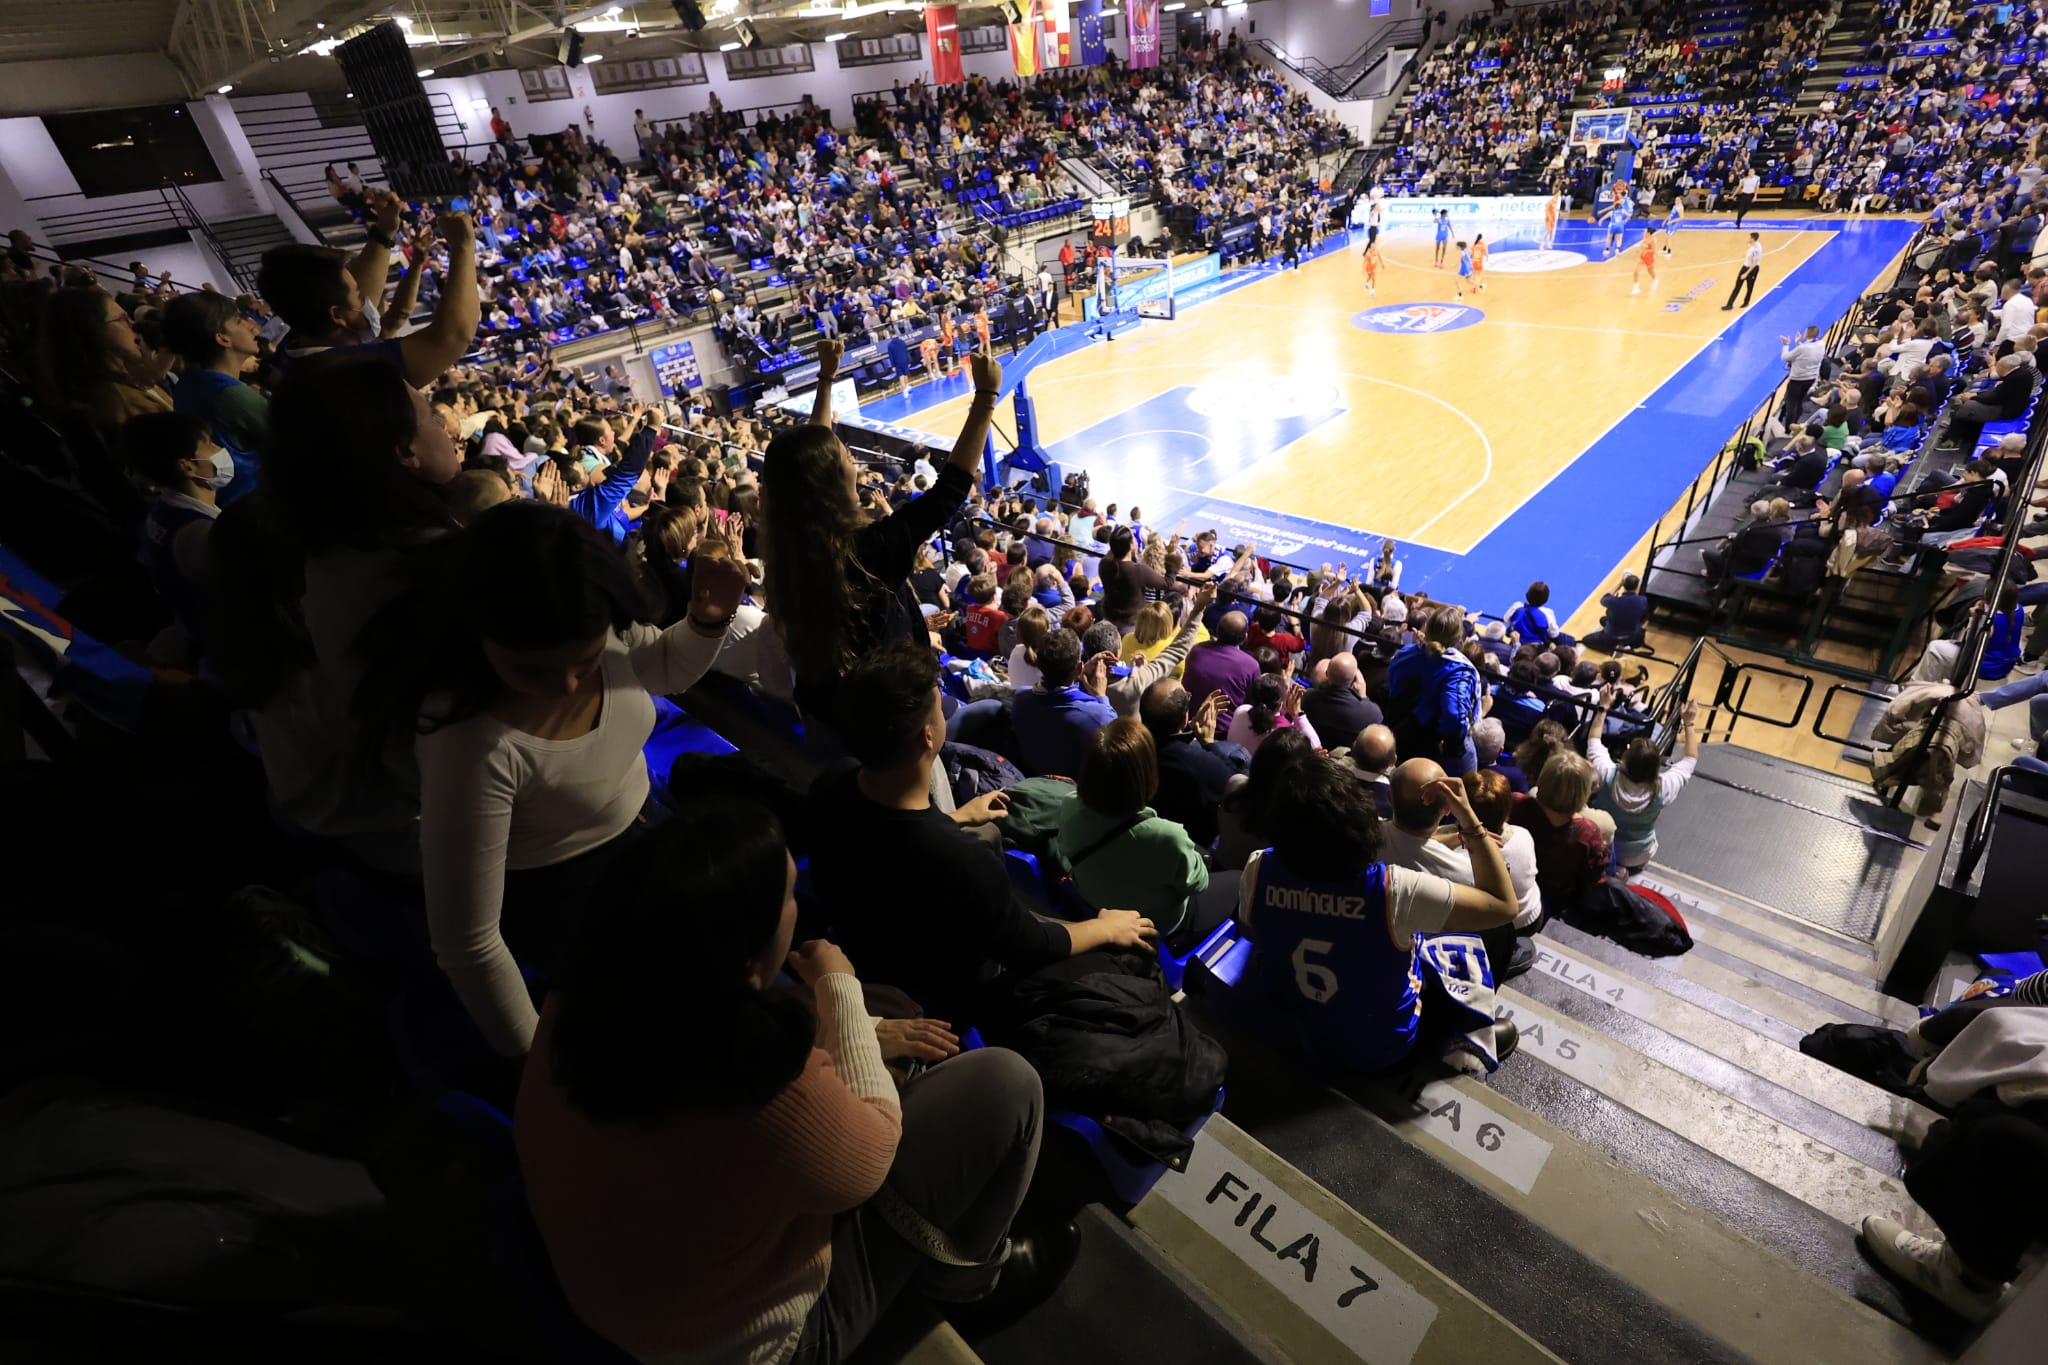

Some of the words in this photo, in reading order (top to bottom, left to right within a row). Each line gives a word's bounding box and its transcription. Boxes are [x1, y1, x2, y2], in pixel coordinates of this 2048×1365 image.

[1094, 219, 1113, 236] 24
[1114, 216, 1129, 236] 24
[1291, 938, 1339, 1004] 6
[1534, 951, 1597, 992] FILA
[1605, 987, 1626, 1003] 4
[1555, 1038, 1581, 1060] 5
[1476, 1122, 1505, 1152] 6
[1205, 1171, 1320, 1283] FILA
[1337, 1265, 1379, 1308] 7
